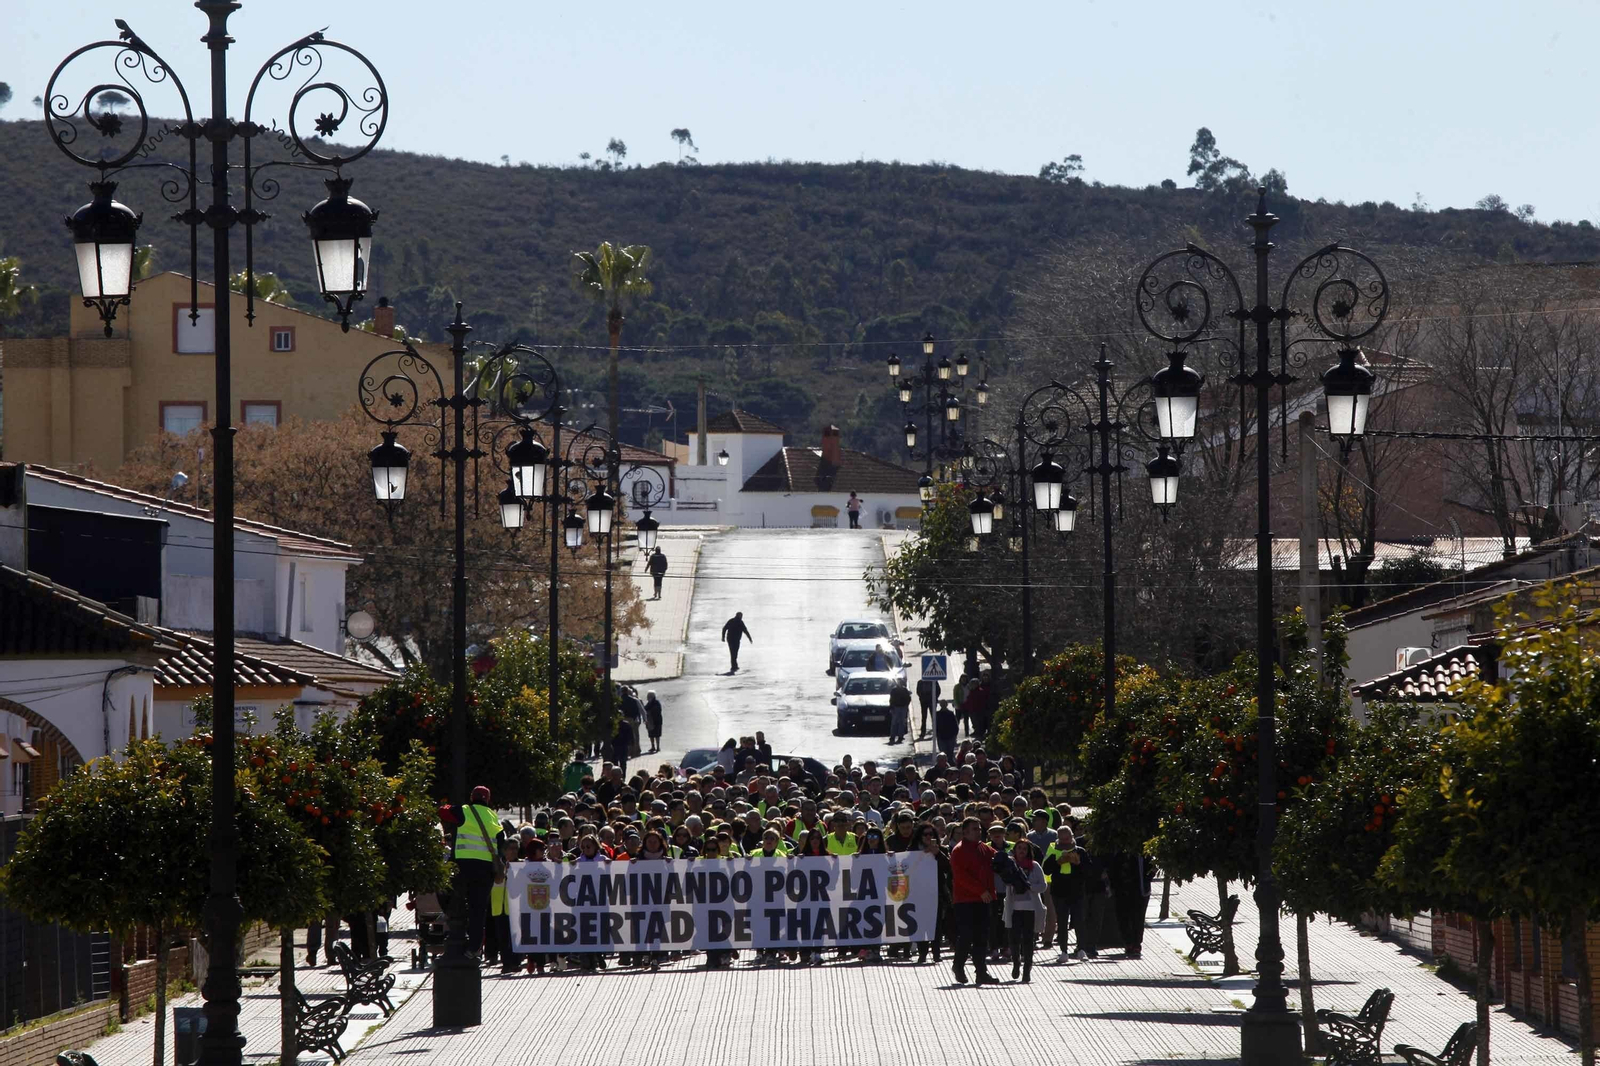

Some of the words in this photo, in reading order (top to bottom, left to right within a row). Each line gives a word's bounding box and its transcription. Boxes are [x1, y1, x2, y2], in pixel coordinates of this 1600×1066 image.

[559, 870, 753, 907] CAMINANDO
[764, 869, 831, 903] POR
[842, 868, 879, 902] LA
[520, 910, 695, 946] LIBERTAD
[708, 909, 752, 943] DE
[764, 902, 918, 942] THARSIS
